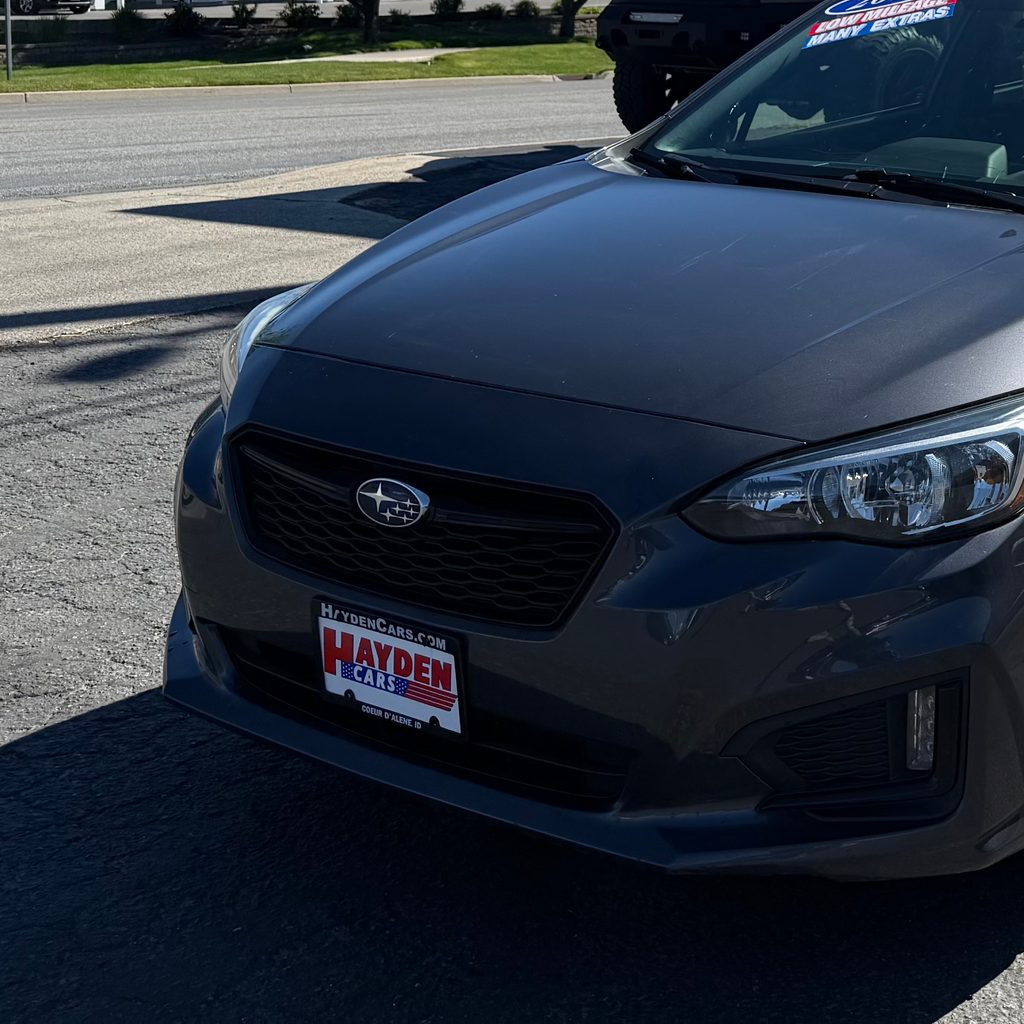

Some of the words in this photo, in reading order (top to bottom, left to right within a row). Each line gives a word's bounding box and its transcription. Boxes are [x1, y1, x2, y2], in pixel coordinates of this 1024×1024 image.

[806, 23, 865, 48] MANY
[869, 5, 951, 33] EXTRAS
[815, 13, 862, 33] LOW
[323, 626, 452, 692] HAYDEN
[353, 665, 396, 693] CARS
[361, 704, 384, 718] COEUR
[414, 722, 422, 730] ID
